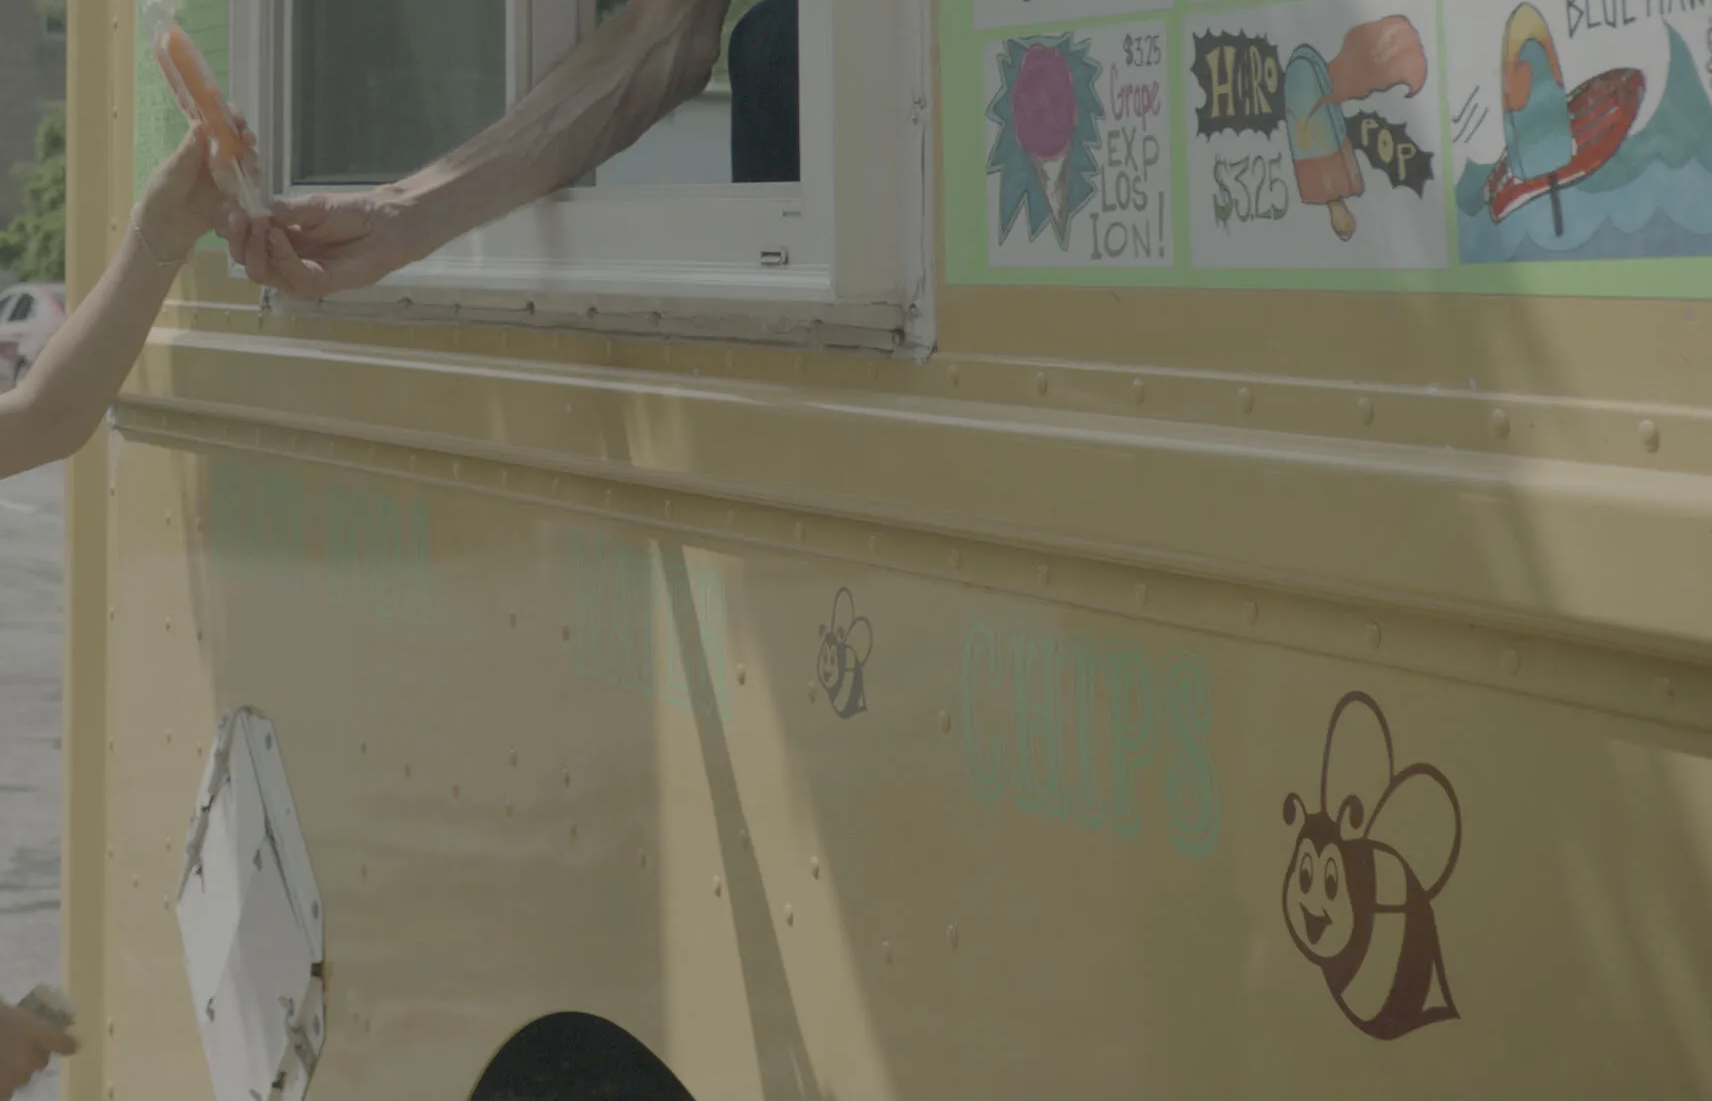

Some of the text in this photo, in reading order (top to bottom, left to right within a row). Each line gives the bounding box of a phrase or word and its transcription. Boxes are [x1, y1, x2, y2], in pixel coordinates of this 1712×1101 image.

[1110, 62, 1162, 133] Grape
[1107, 126, 1160, 182] EXP
[1360, 118, 1416, 182] POP
[1101, 163, 1148, 212] LOS
[1089, 191, 1165, 259] ION!
[958, 611, 1221, 857] CHIPS
